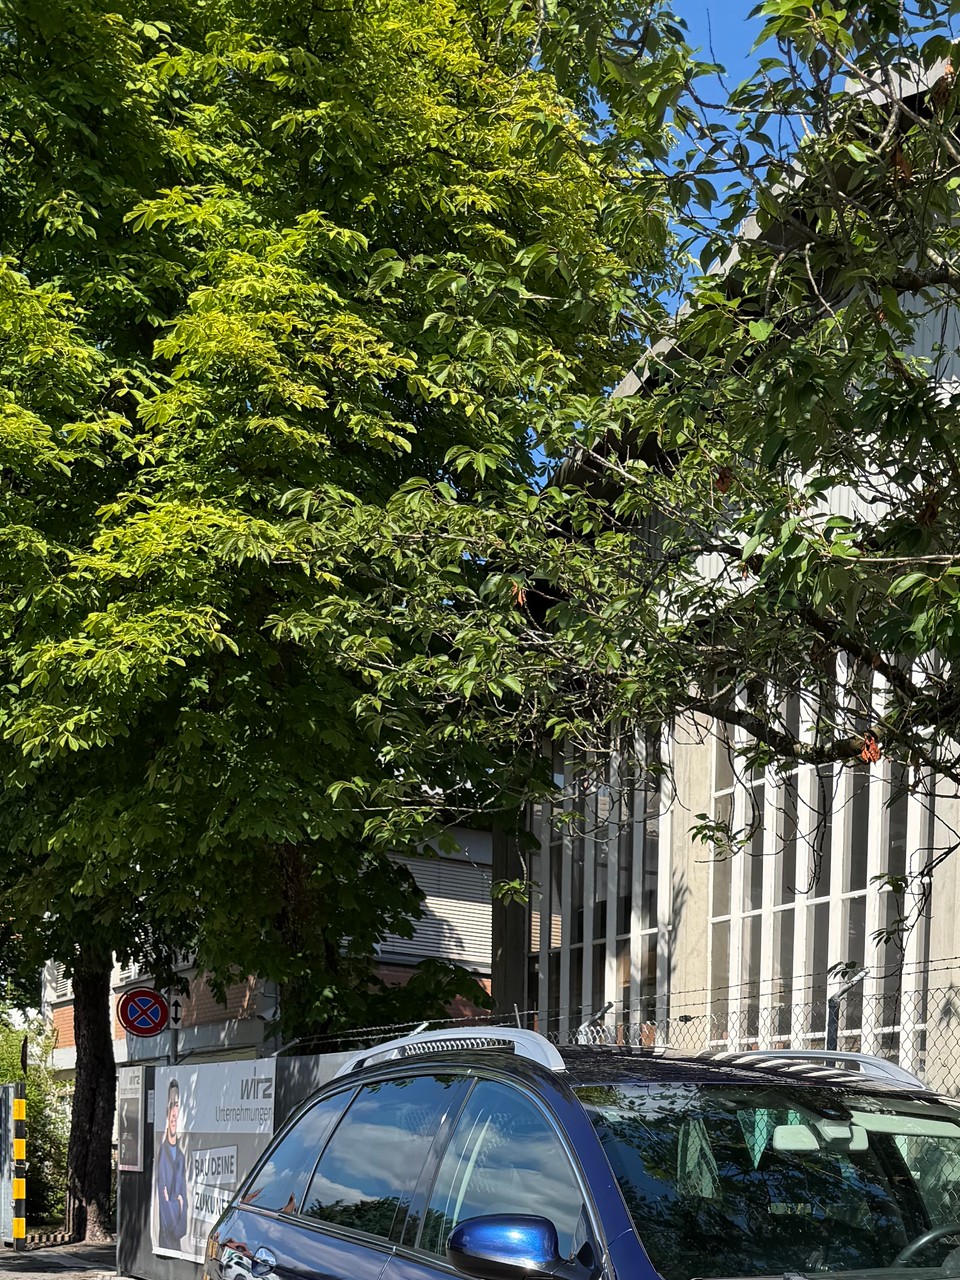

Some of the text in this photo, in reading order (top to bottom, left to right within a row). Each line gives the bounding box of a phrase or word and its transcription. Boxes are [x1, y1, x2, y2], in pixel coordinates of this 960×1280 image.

[241, 1066, 273, 1100] wirz
[215, 1105, 273, 1127] Unternehmungen
[195, 1154, 235, 1178] BAU DEINE
